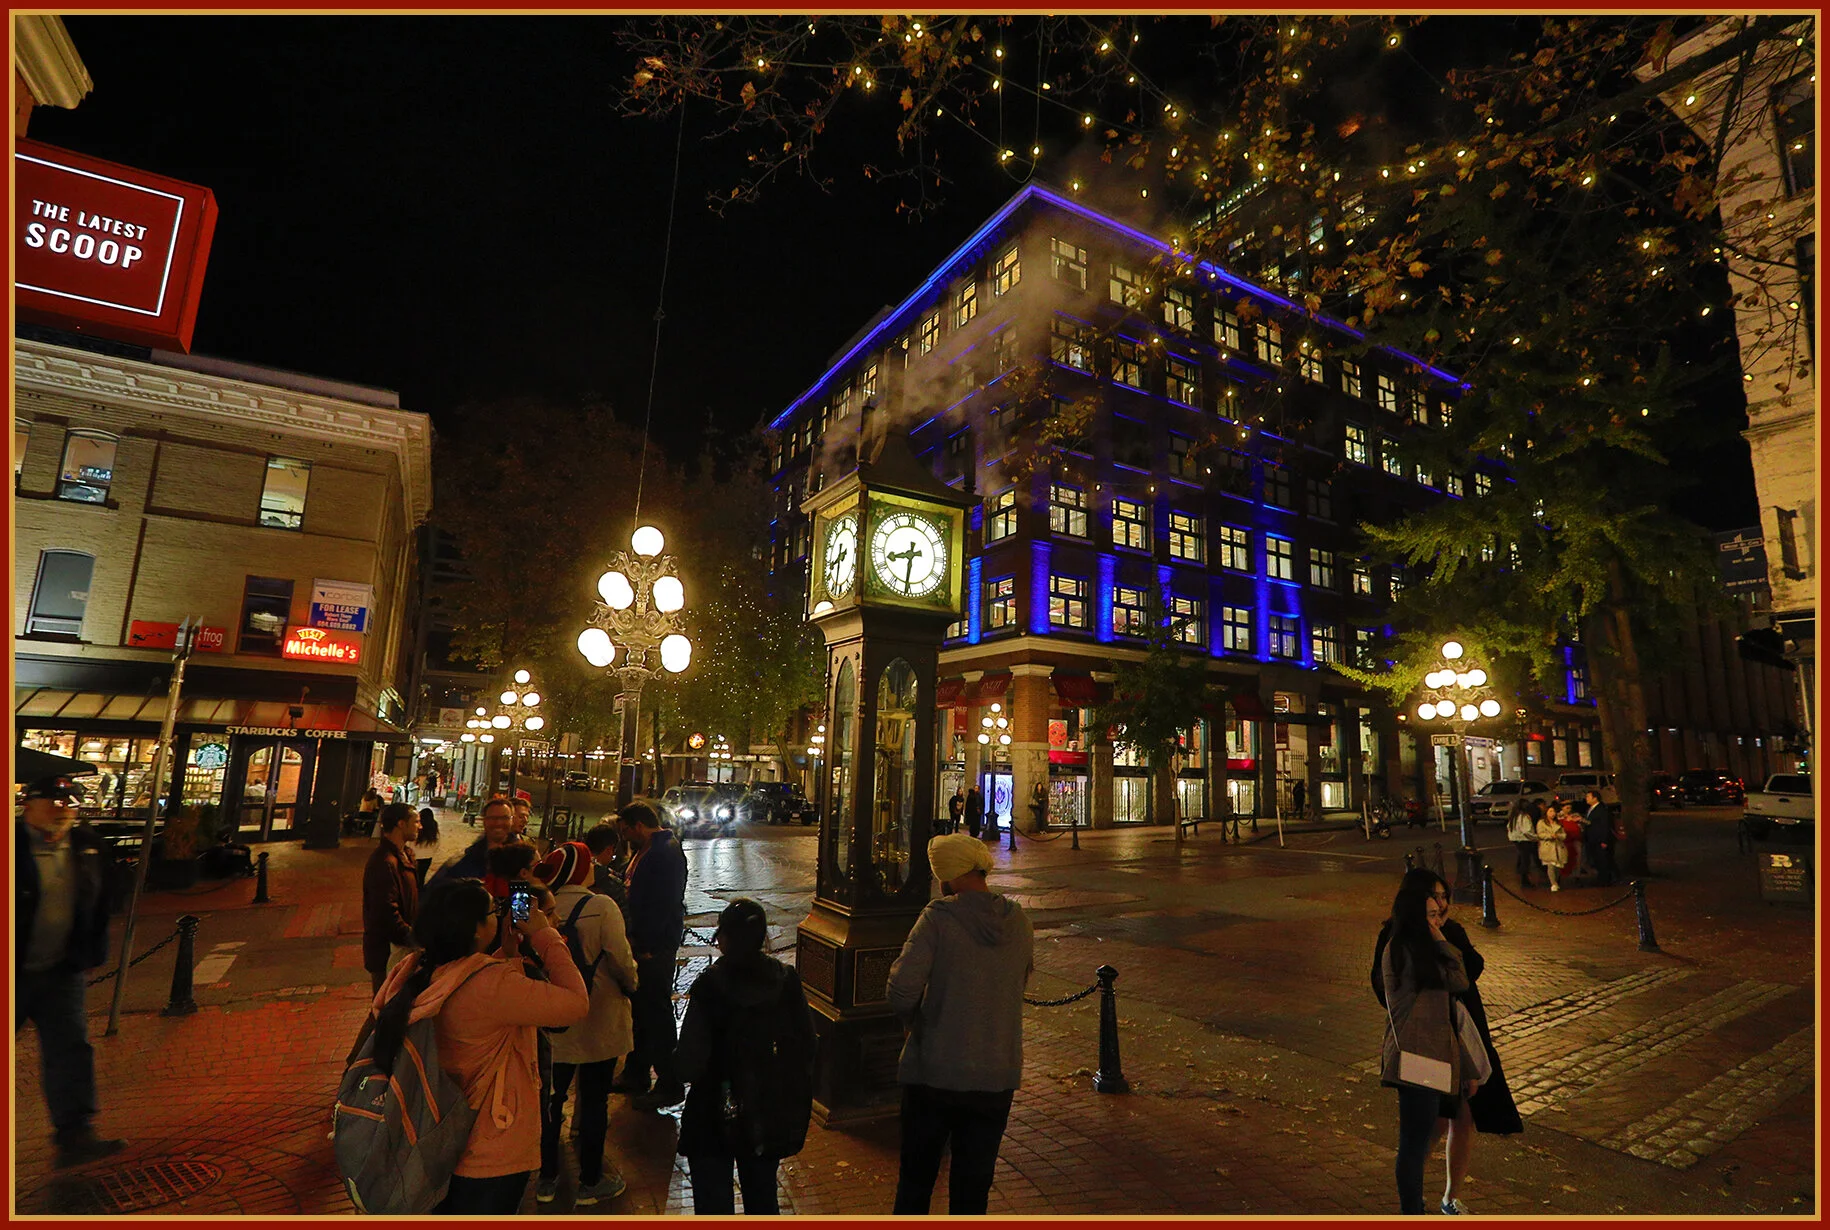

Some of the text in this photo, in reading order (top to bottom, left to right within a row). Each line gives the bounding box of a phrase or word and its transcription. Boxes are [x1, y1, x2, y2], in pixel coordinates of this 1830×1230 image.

[32, 199, 147, 241] THE LATEST
[25, 222, 144, 269] SCOOP
[319, 604, 360, 615] FOR LEASE
[203, 628, 223, 646] frog
[298, 629, 325, 642] VISIT
[286, 640, 358, 660] Michelle's
[225, 726, 348, 740] STARBUCKS COFFEE
